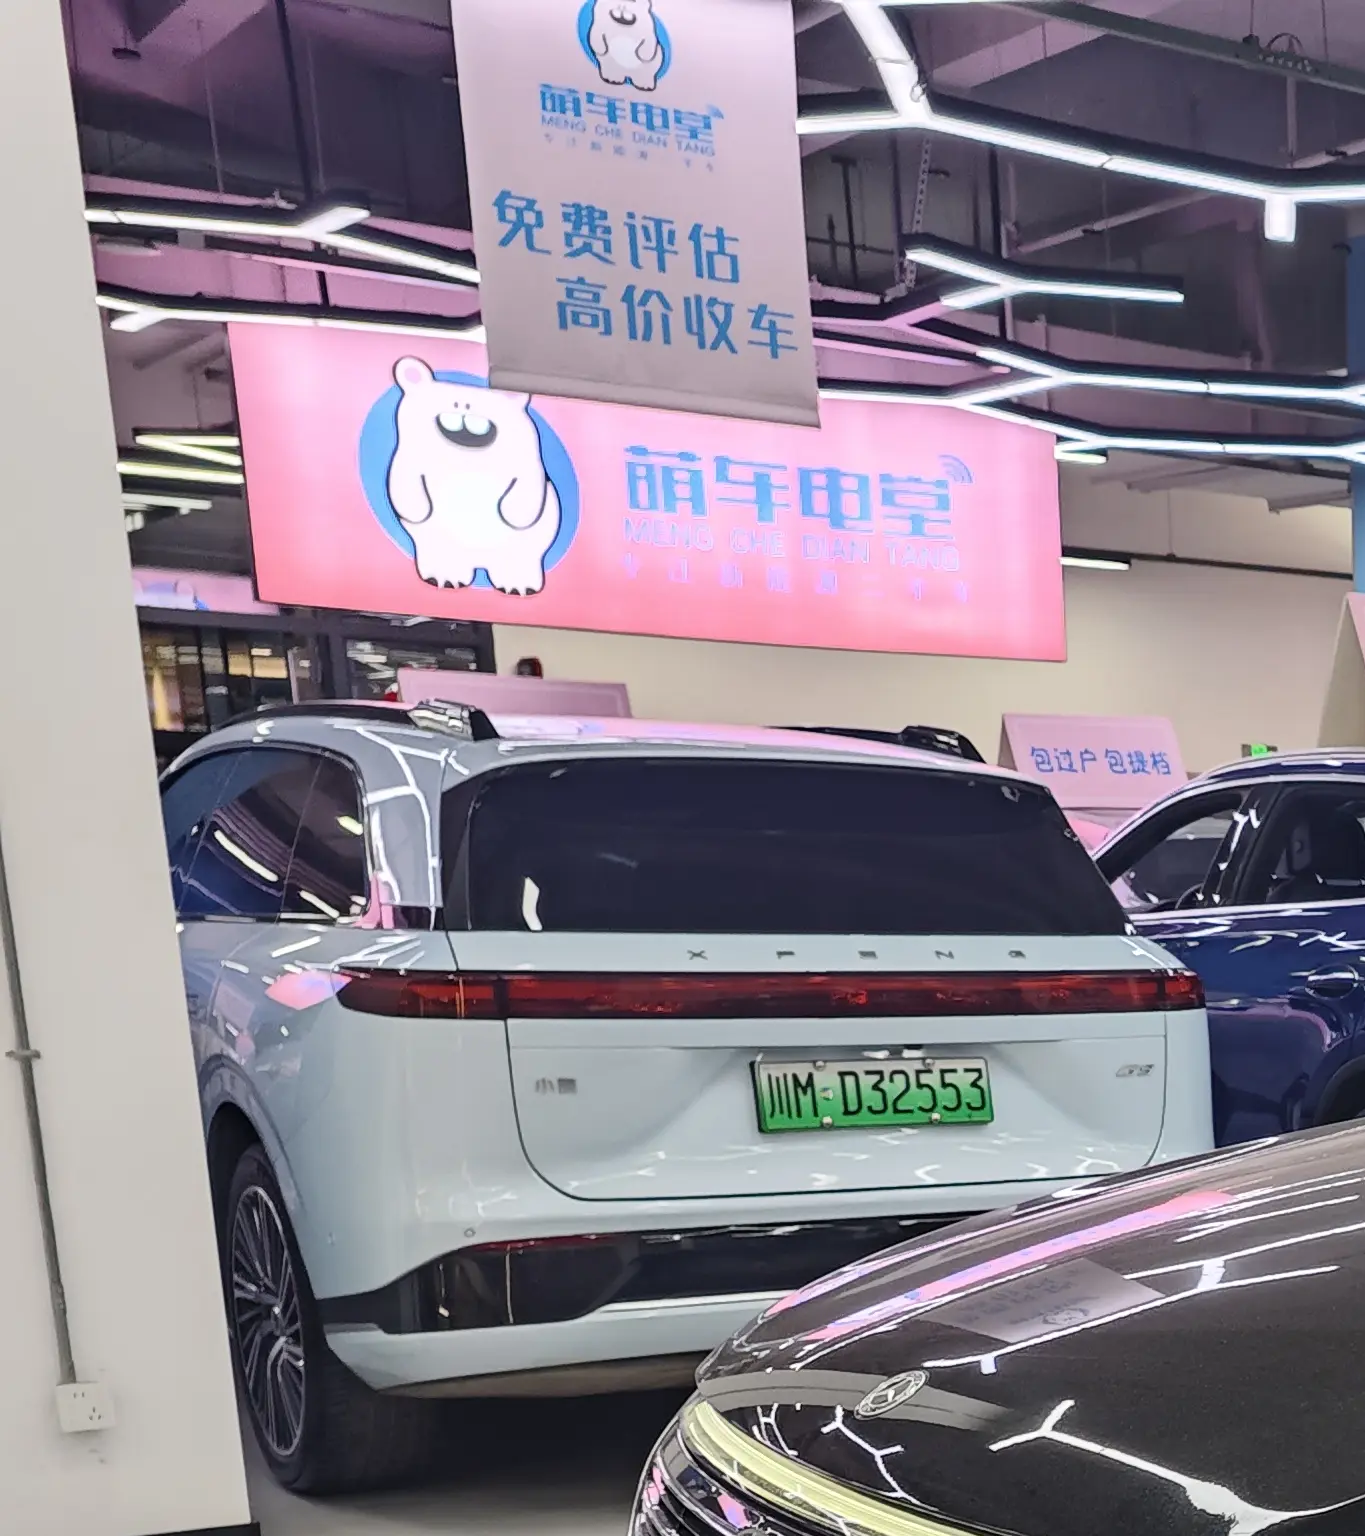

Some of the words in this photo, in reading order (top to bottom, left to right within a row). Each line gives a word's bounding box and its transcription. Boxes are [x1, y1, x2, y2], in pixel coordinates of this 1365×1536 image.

[539, 83, 714, 143] 萌车电堂
[541, 114, 587, 132] MENG
[595, 124, 623, 139] CHE
[632, 130, 668, 148] DIAN
[676, 139, 716, 158] TANG
[492, 189, 740, 285] 免费评估
[556, 276, 798, 359] 高价收车
[624, 445, 954, 540] 萌车电堂
[623, 516, 714, 551] MENG
[729, 527, 788, 558] CHE
[802, 534, 870, 565] DIAN
[886, 541, 960, 573] TANG
[1031, 746, 1097, 773] 包过户
